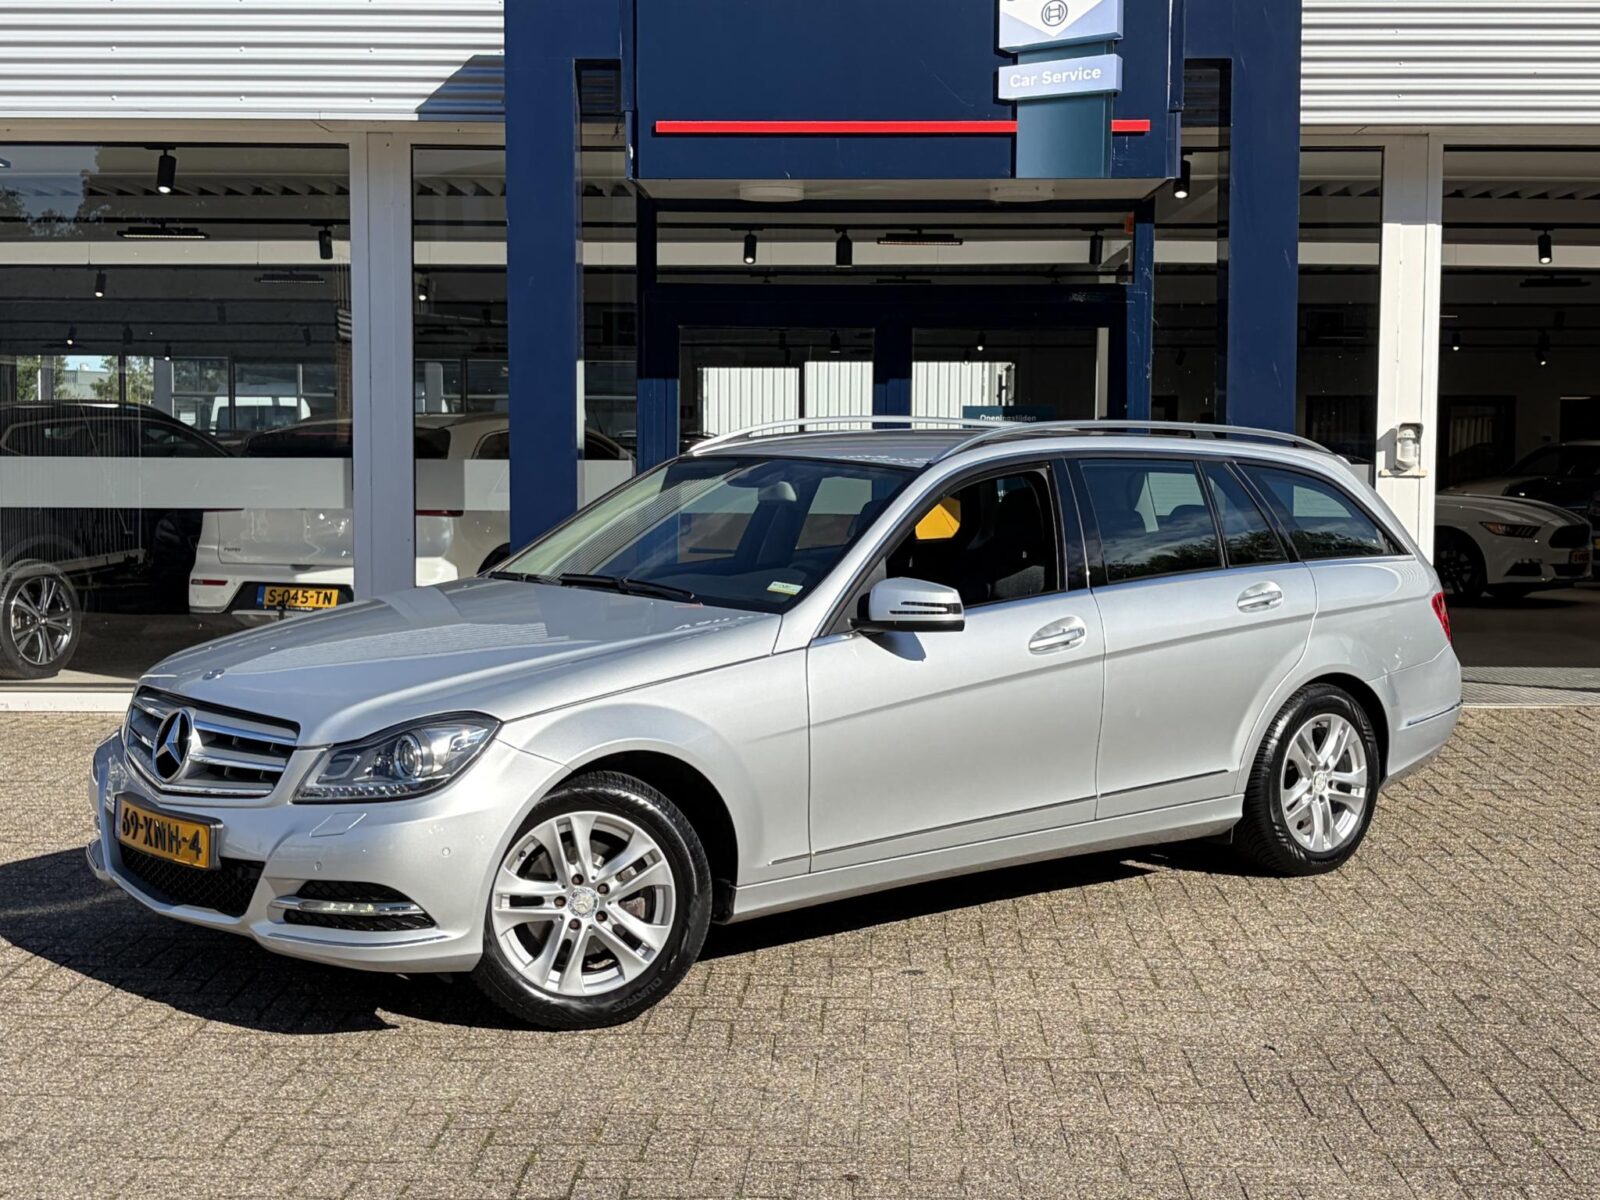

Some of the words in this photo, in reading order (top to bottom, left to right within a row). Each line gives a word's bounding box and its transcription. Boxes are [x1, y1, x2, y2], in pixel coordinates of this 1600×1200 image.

[1009, 74, 1037, 88] Car
[1041, 66, 1102, 85] Service
[267, 588, 333, 606] S-045-TN
[122, 807, 203, 860] 69-XNH-4
